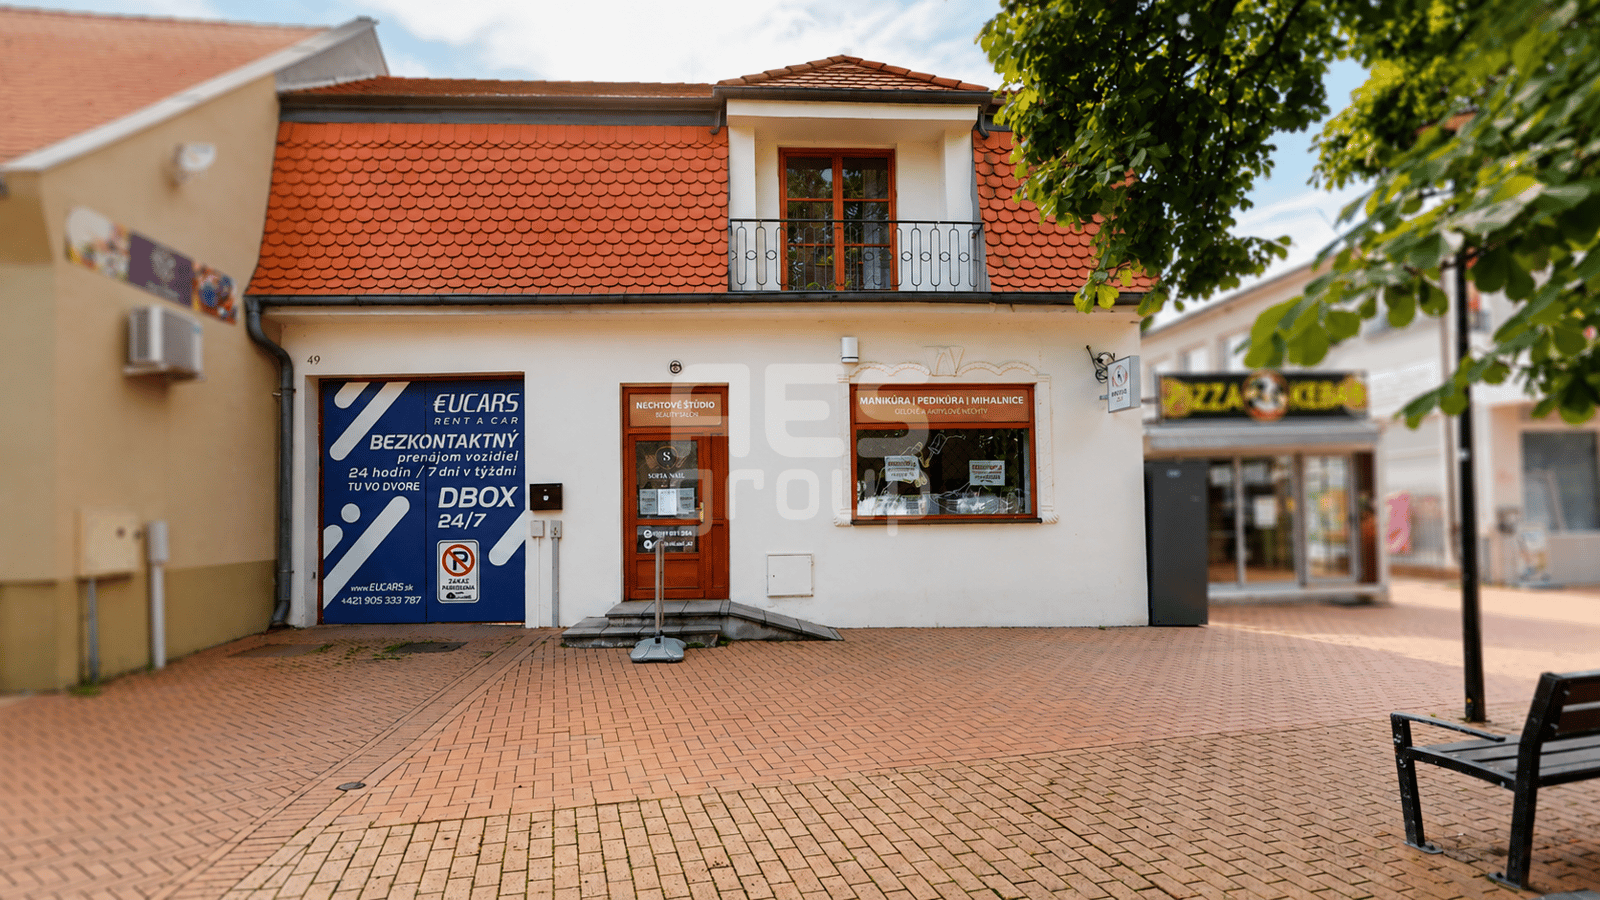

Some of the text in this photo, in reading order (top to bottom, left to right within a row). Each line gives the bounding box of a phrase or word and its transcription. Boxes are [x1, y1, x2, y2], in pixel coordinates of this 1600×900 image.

[307, 354, 321, 365] 49
[636, 399, 715, 409] NECHTOVÉ ŠTÚDIO
[971, 396, 1024, 405] MIHALNICE
[434, 416, 519, 426] RENT A CAR
[370, 429, 520, 450] BEZKONTAKTNÝ
[397, 450, 519, 465] prenájom vozidiel
[662, 451, 671, 461] S
[348, 467, 369, 478] 24
[428, 466, 437, 477] 7
[463, 468, 471, 477] v
[475, 465, 517, 479] týždni
[348, 482, 420, 491] TU VO DVORE
[438, 486, 518, 508] DBOX
[437, 511, 487, 530] 24/7
[341, 595, 422, 605] +421 905 333 787
